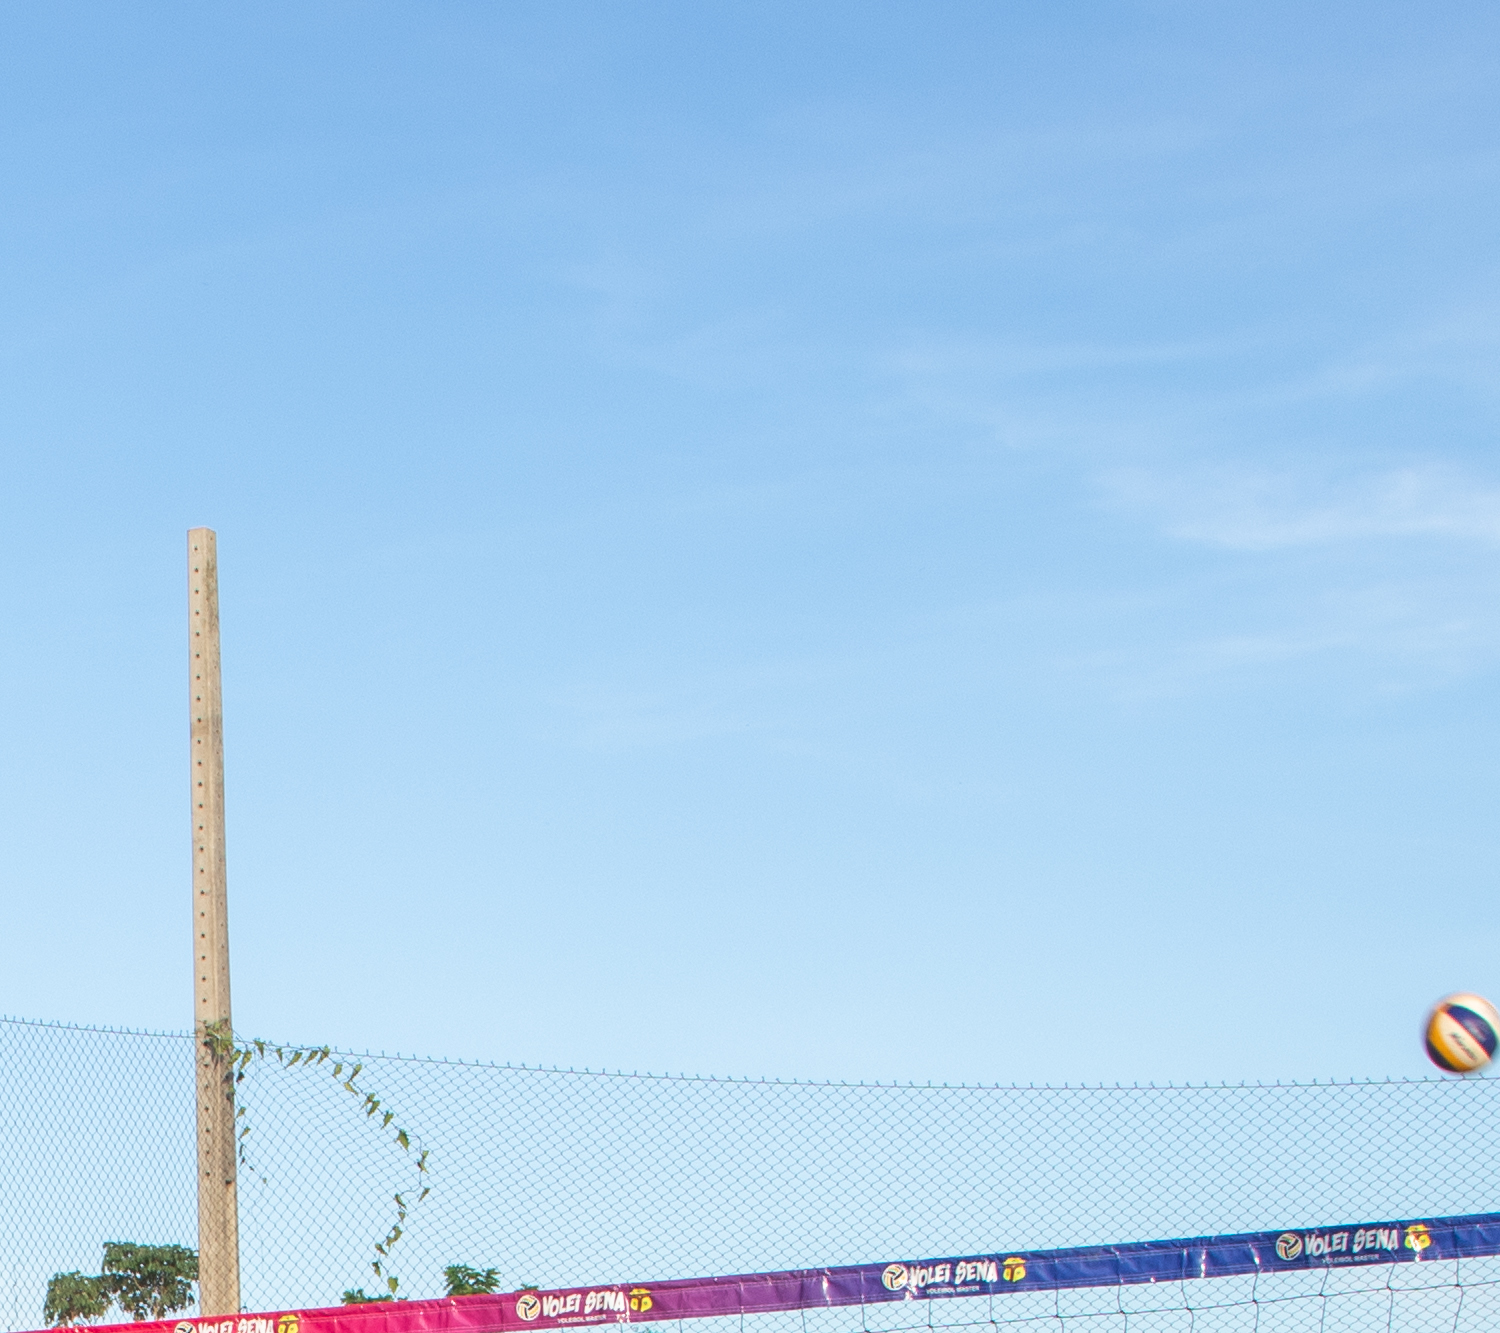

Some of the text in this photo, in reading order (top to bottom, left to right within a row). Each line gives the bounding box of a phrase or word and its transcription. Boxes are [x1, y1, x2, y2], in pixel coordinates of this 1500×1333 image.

[1352, 1228, 1399, 1254] SENA
[954, 1261, 998, 1285] SENA
[584, 1290, 626, 1314] SENA
